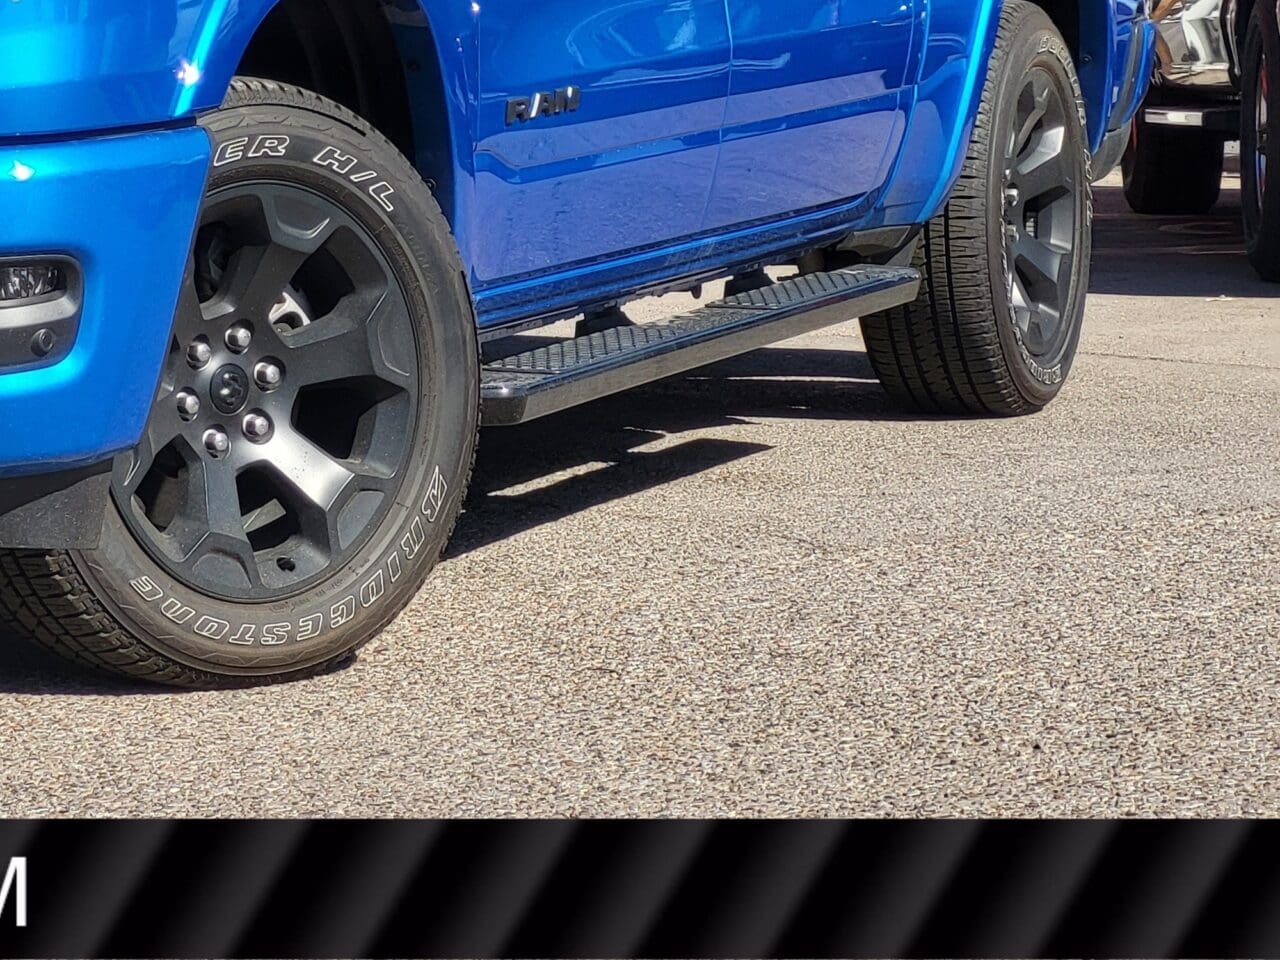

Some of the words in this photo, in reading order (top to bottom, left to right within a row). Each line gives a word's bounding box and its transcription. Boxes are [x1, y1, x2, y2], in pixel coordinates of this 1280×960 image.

[505, 86, 580, 127] RAM
[213, 135, 290, 167] ER
[312, 146, 395, 212] H/L
[130, 465, 449, 645] BRIDGESTONE
